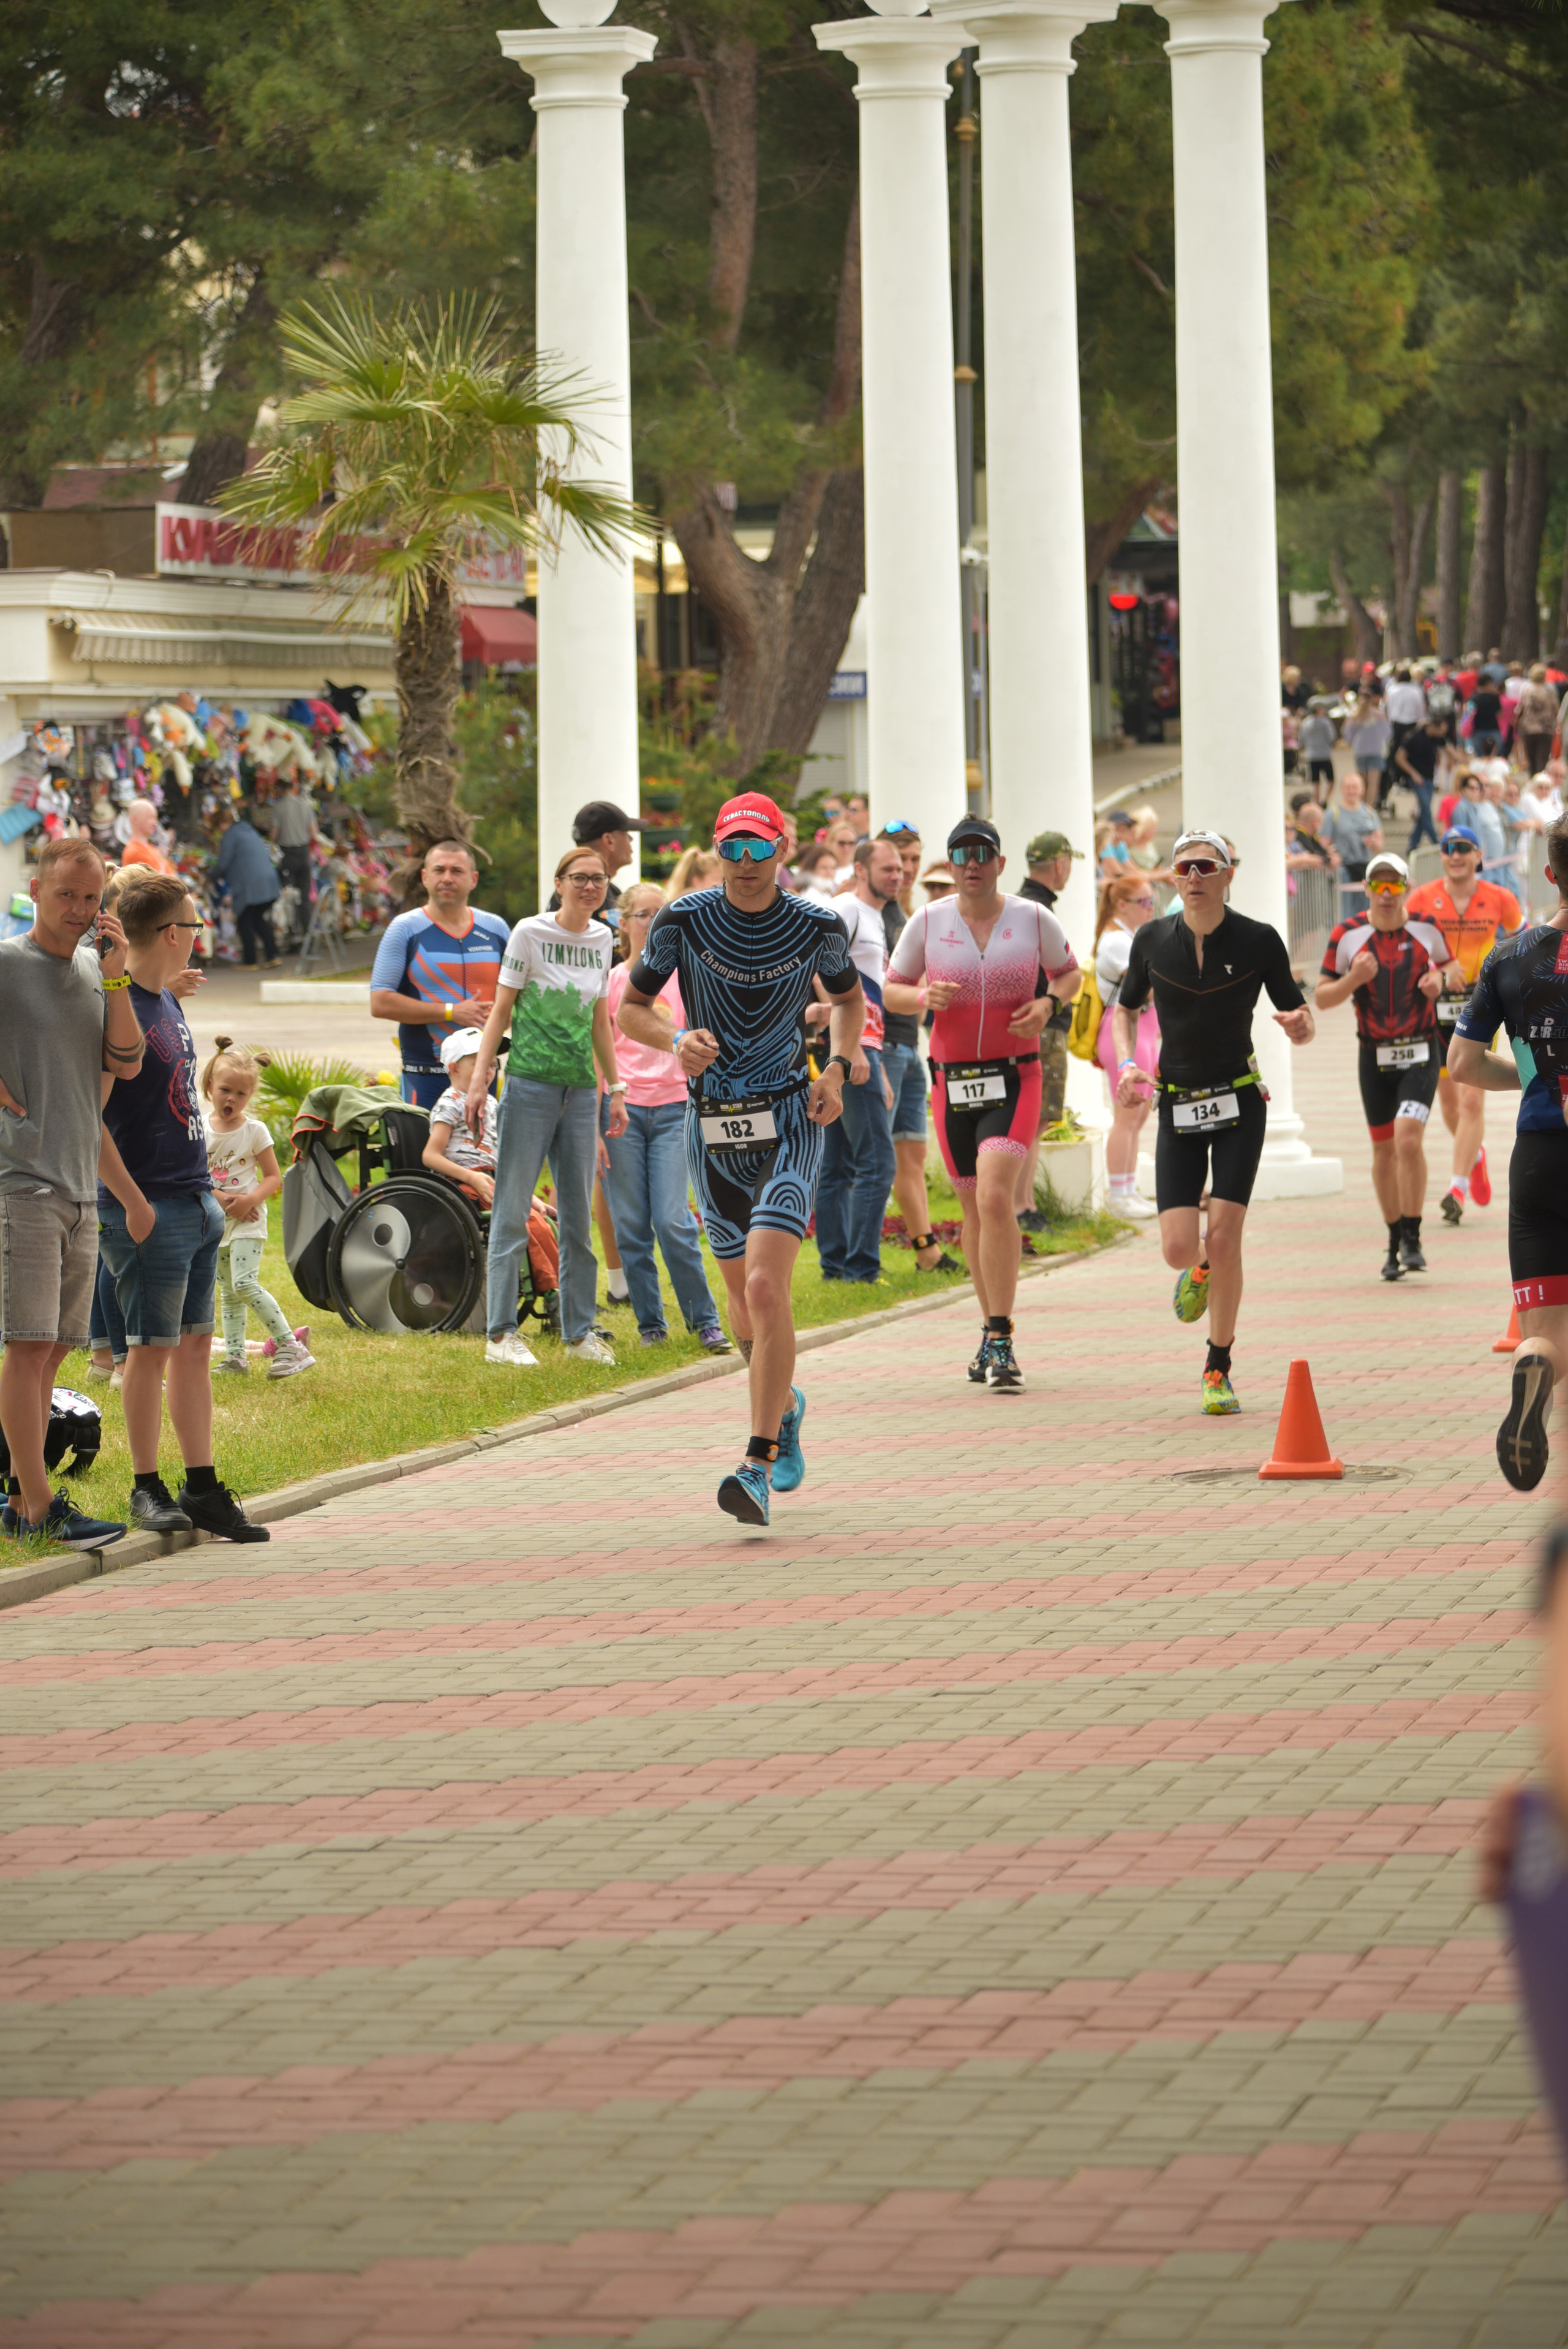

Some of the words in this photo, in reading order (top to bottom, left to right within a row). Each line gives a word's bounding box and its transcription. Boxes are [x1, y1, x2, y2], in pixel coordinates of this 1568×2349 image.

[723, 810, 770, 823] СЕВАСТОПОЛЬ
[543, 942, 603, 969] IZMYLONG
[701, 950, 756, 983] Champions
[759, 956, 802, 981] Factory
[1391, 1048, 1414, 1061] 258
[962, 1083, 985, 1099] 117
[1191, 1102, 1220, 1121] 134
[720, 1119, 755, 1138] 182
[1514, 1286, 1531, 1306] TT
